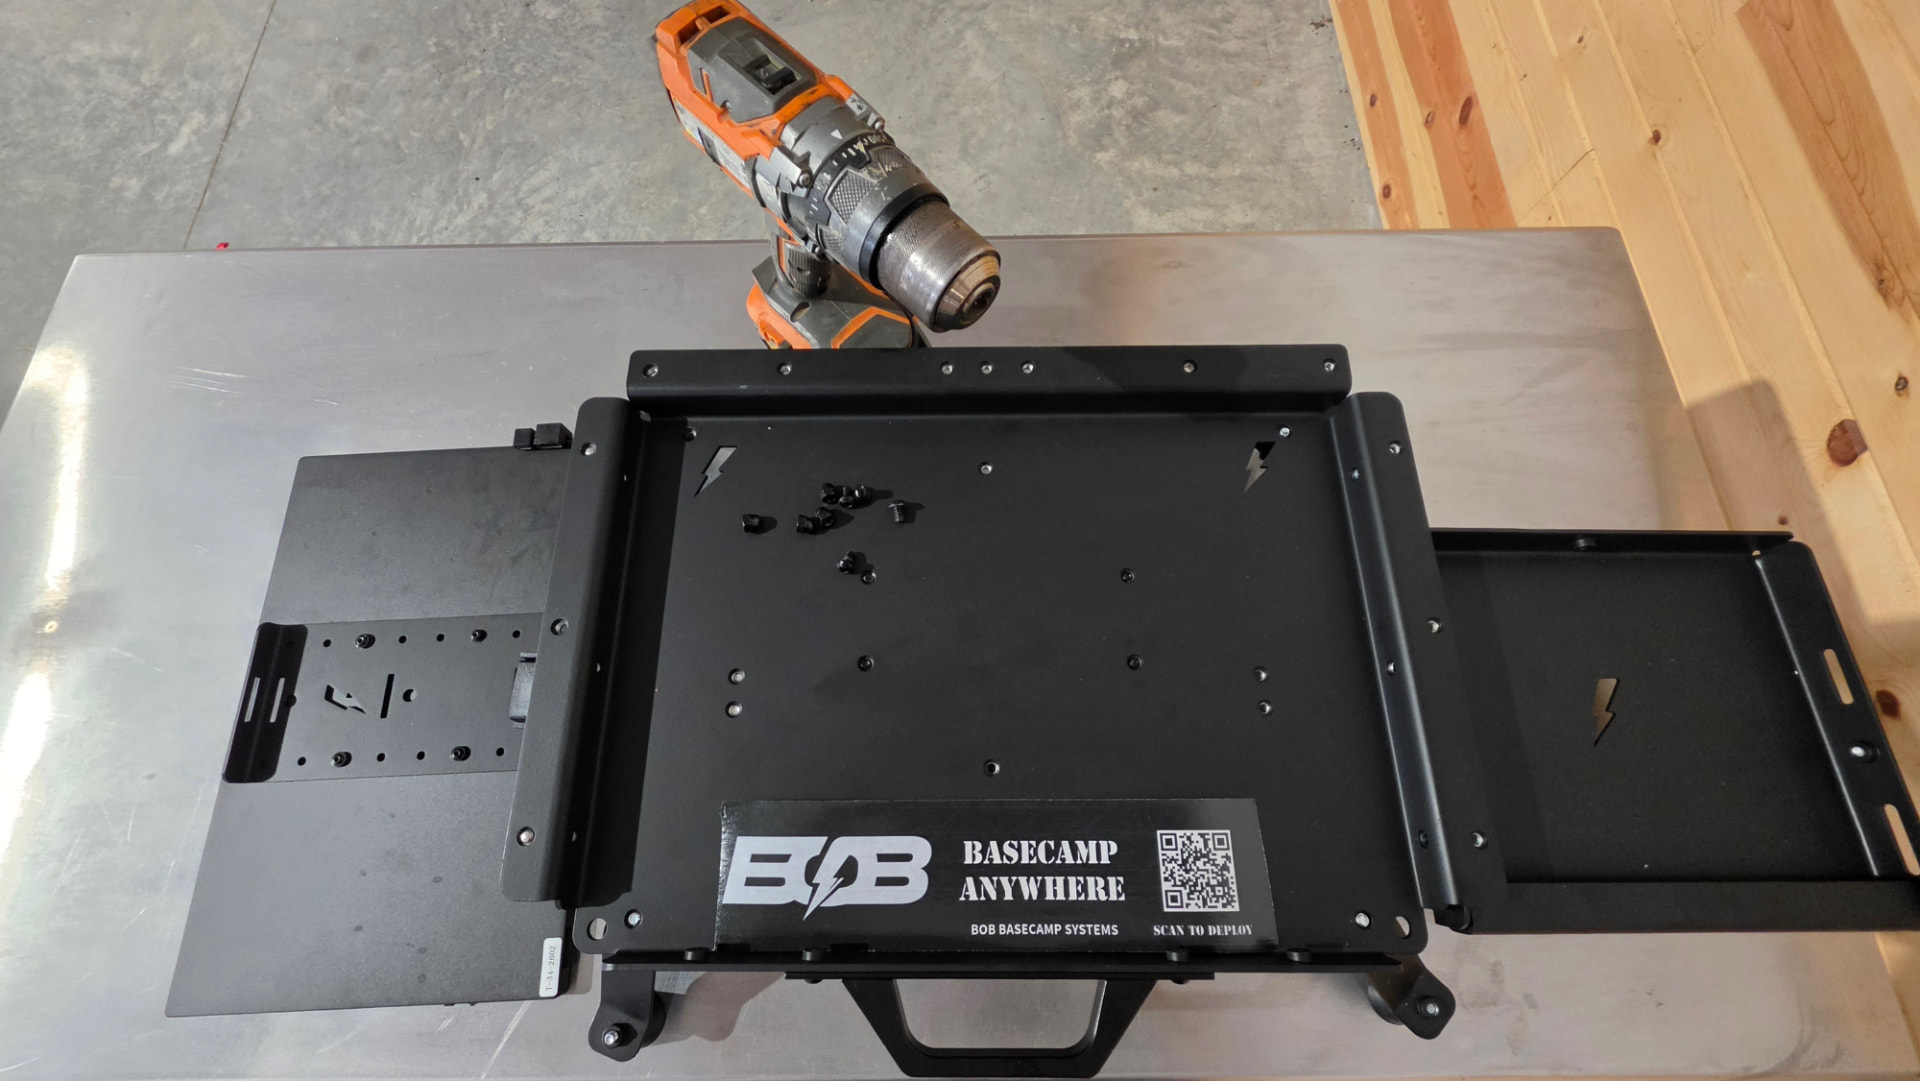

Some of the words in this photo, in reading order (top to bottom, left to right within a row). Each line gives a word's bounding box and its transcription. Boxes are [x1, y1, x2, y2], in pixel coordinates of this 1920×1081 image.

[963, 840, 1119, 865] BASECAMP
[722, 835, 933, 920] BOB
[958, 876, 1126, 902] ANYWHERE
[970, 924, 996, 936] BOB
[998, 923, 1062, 936] BASECAMP
[1065, 923, 1119, 936] SYSTEMS
[1153, 924, 1185, 936] SCAN
[1188, 924, 1205, 936] TO
[1207, 924, 1253, 936] DEPLOY
